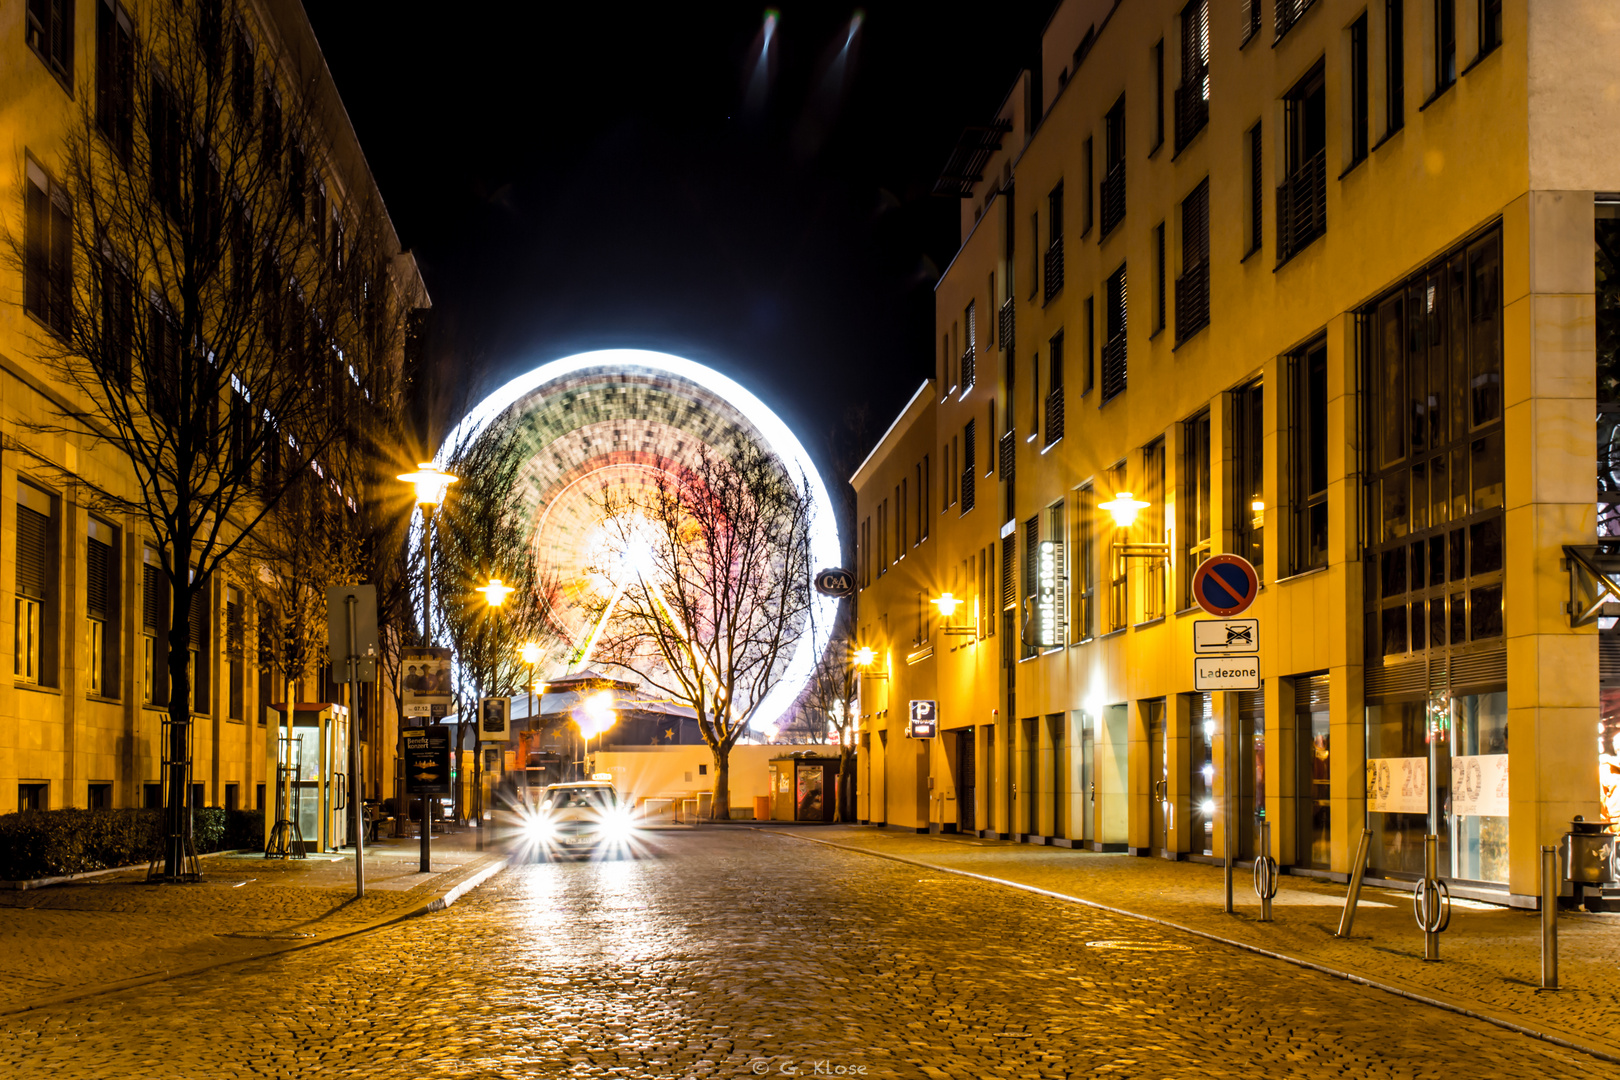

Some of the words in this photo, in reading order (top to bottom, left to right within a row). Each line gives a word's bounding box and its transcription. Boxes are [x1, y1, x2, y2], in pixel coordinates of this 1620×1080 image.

[823, 575, 849, 589] C&A
[1038, 541, 1054, 645] music-store
[1200, 668, 1256, 679] Ladezone
[916, 701, 930, 720] P
[1366, 760, 1390, 800] 20
[1401, 758, 1426, 798] 20
[1452, 757, 1482, 802] 20
[1495, 755, 1509, 799] 2
